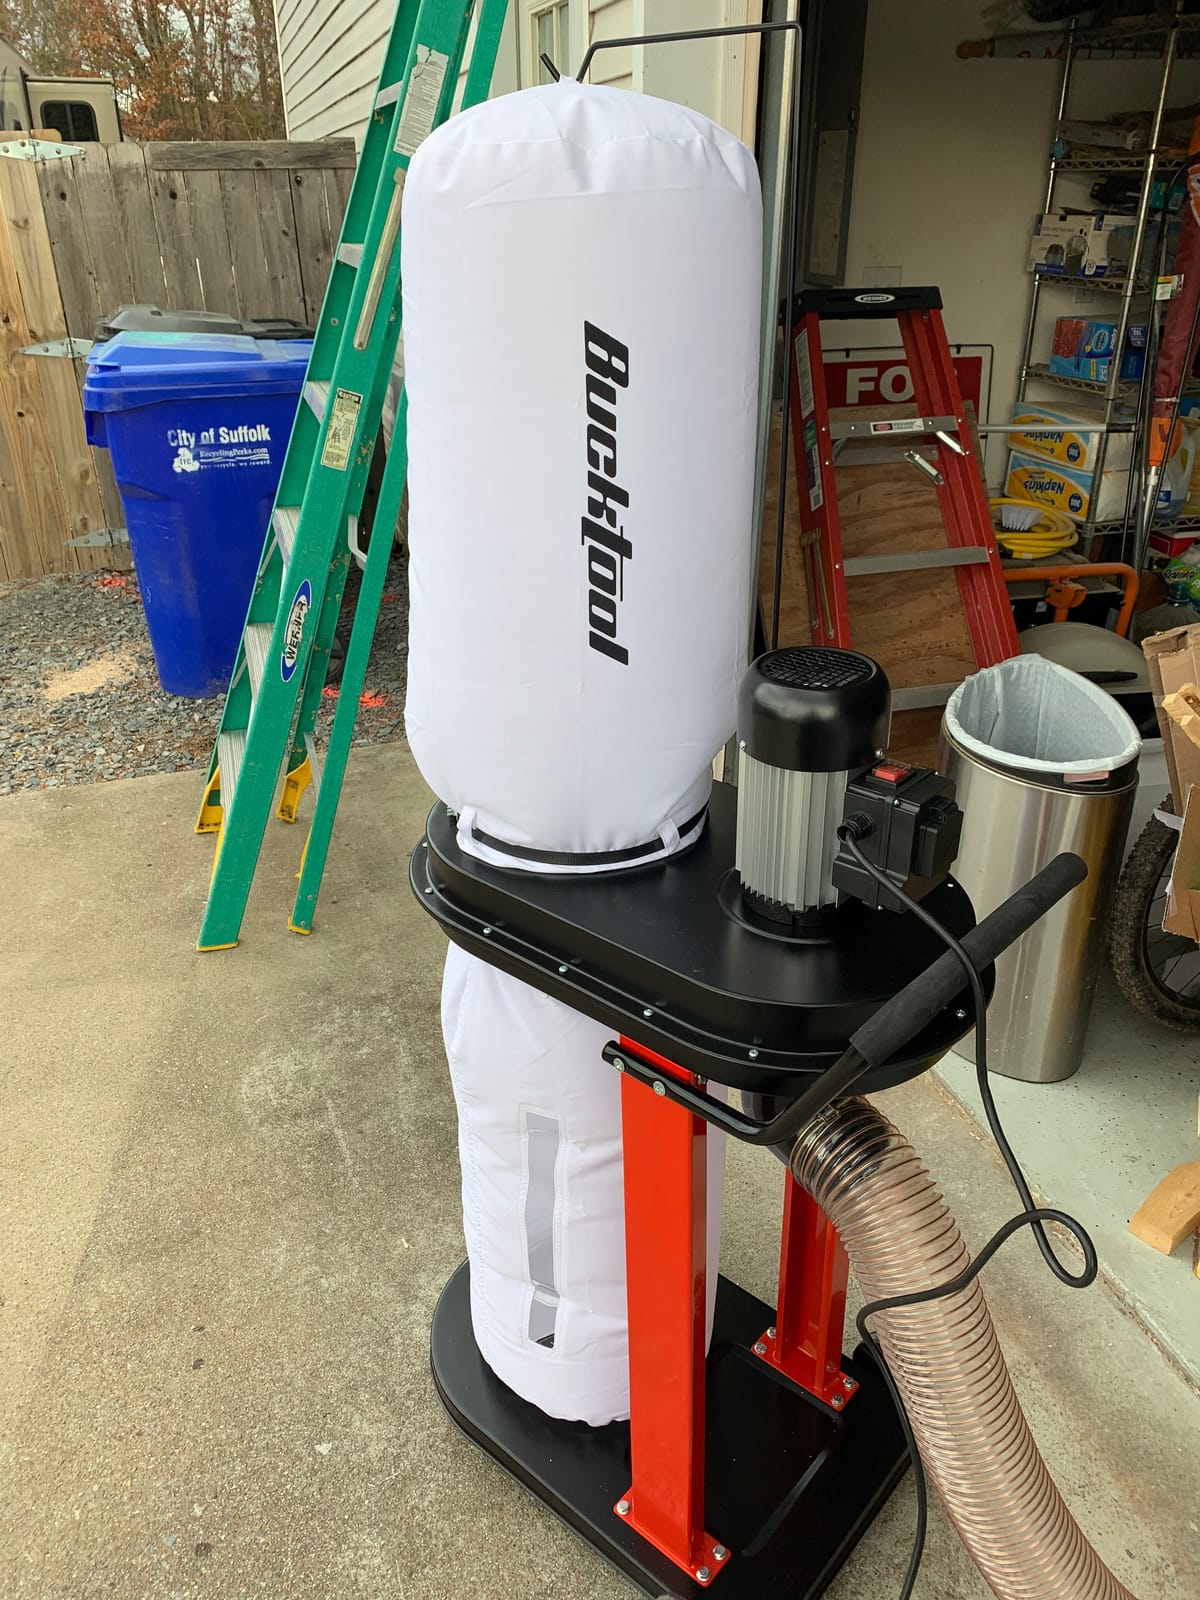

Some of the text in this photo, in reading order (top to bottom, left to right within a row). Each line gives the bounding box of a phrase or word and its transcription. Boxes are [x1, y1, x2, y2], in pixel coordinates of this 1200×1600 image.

[846, 365, 916, 404] FO
[167, 424, 271, 448] City of Suffolk
[1023, 478, 1065, 495] Napkins
